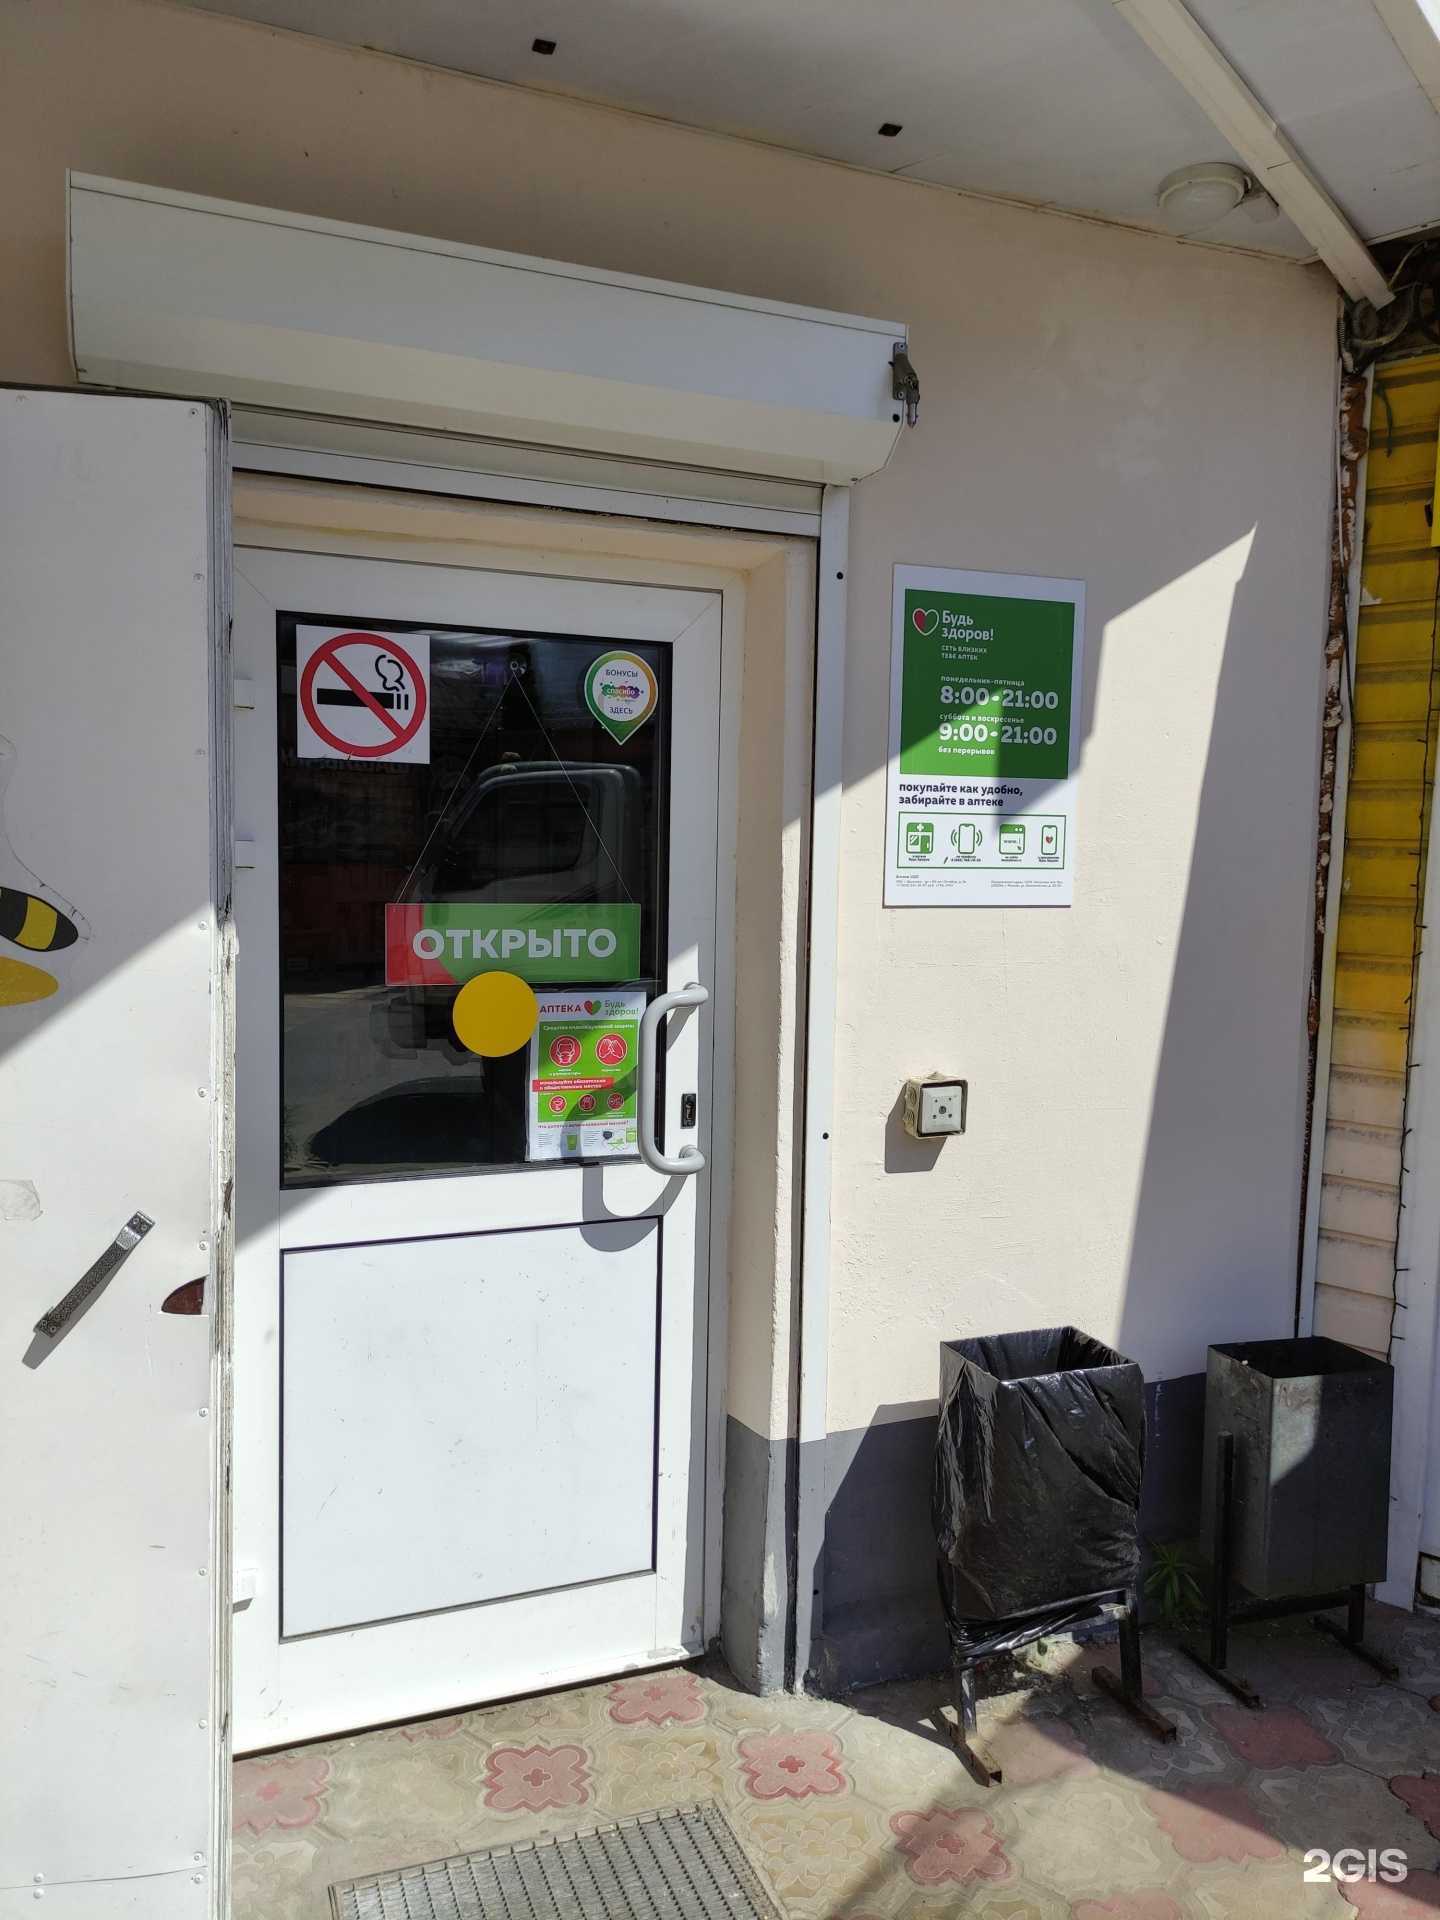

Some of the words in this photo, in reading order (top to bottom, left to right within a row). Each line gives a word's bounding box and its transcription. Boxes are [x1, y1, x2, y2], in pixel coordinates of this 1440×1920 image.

[942, 610, 974, 626] Будь
[942, 627, 994, 642] здоров!
[606, 669, 638, 678] БОНУСЫ
[606, 688, 636, 696] спасибо
[609, 706, 633, 714] ЗДЕСЬ
[939, 713, 970, 722] суббота
[978, 716, 1025, 724] воскресенье
[898, 782, 958, 794] покупайте
[960, 784, 978, 794] как
[981, 784, 1024, 796] удобно,
[898, 795, 957, 807] забирайте
[959, 798, 965, 806] в
[967, 798, 1004, 808] аптеке
[412, 928, 617, 960] ОТКРЫТО
[540, 1004, 582, 1014] АПТЕКА
[604, 1000, 626, 1008] Будь
[604, 1008, 640, 1016] здоров!
